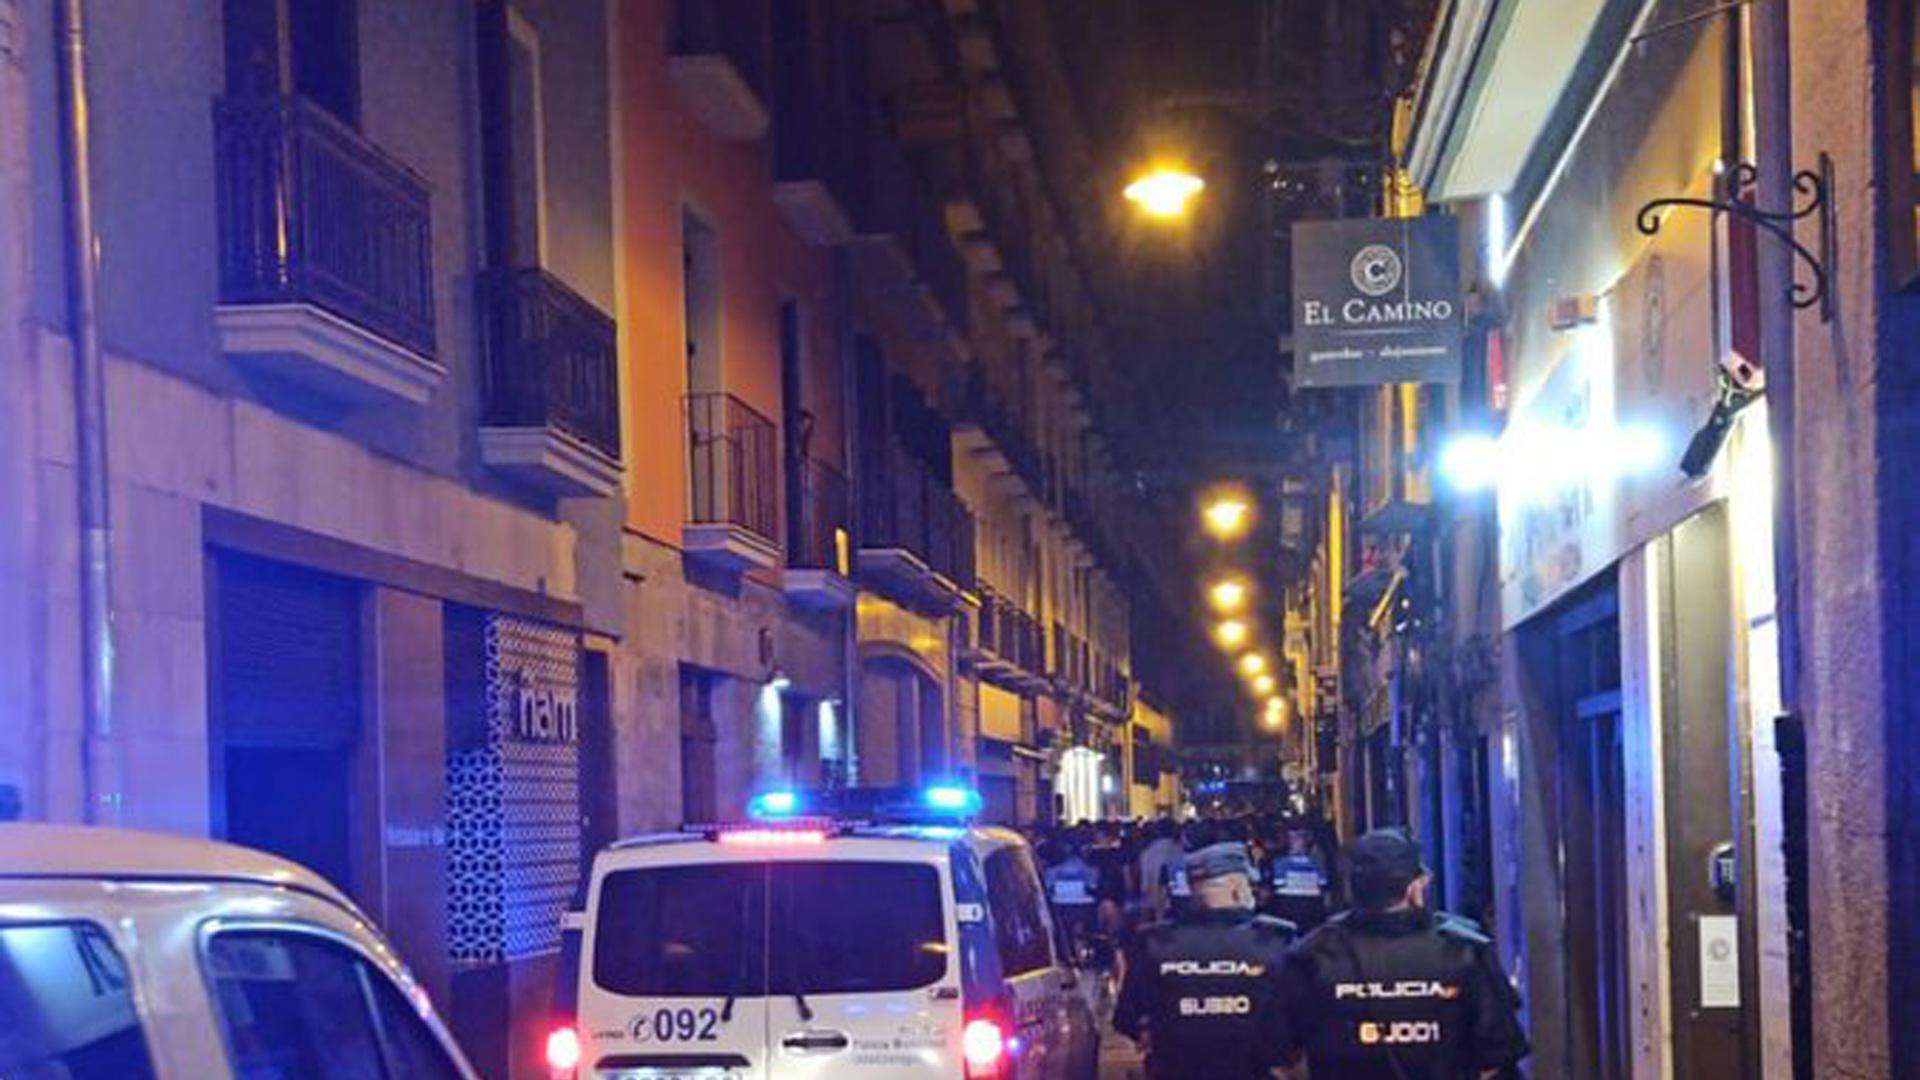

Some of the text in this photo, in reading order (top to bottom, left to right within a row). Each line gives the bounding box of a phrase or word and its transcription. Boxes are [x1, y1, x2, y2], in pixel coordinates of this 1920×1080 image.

[1303, 299, 1452, 325] EL CAMINO
[1160, 961, 1251, 976] POLICIA
[1335, 981, 1444, 999] POLICIA
[655, 1008, 718, 1042] 092
